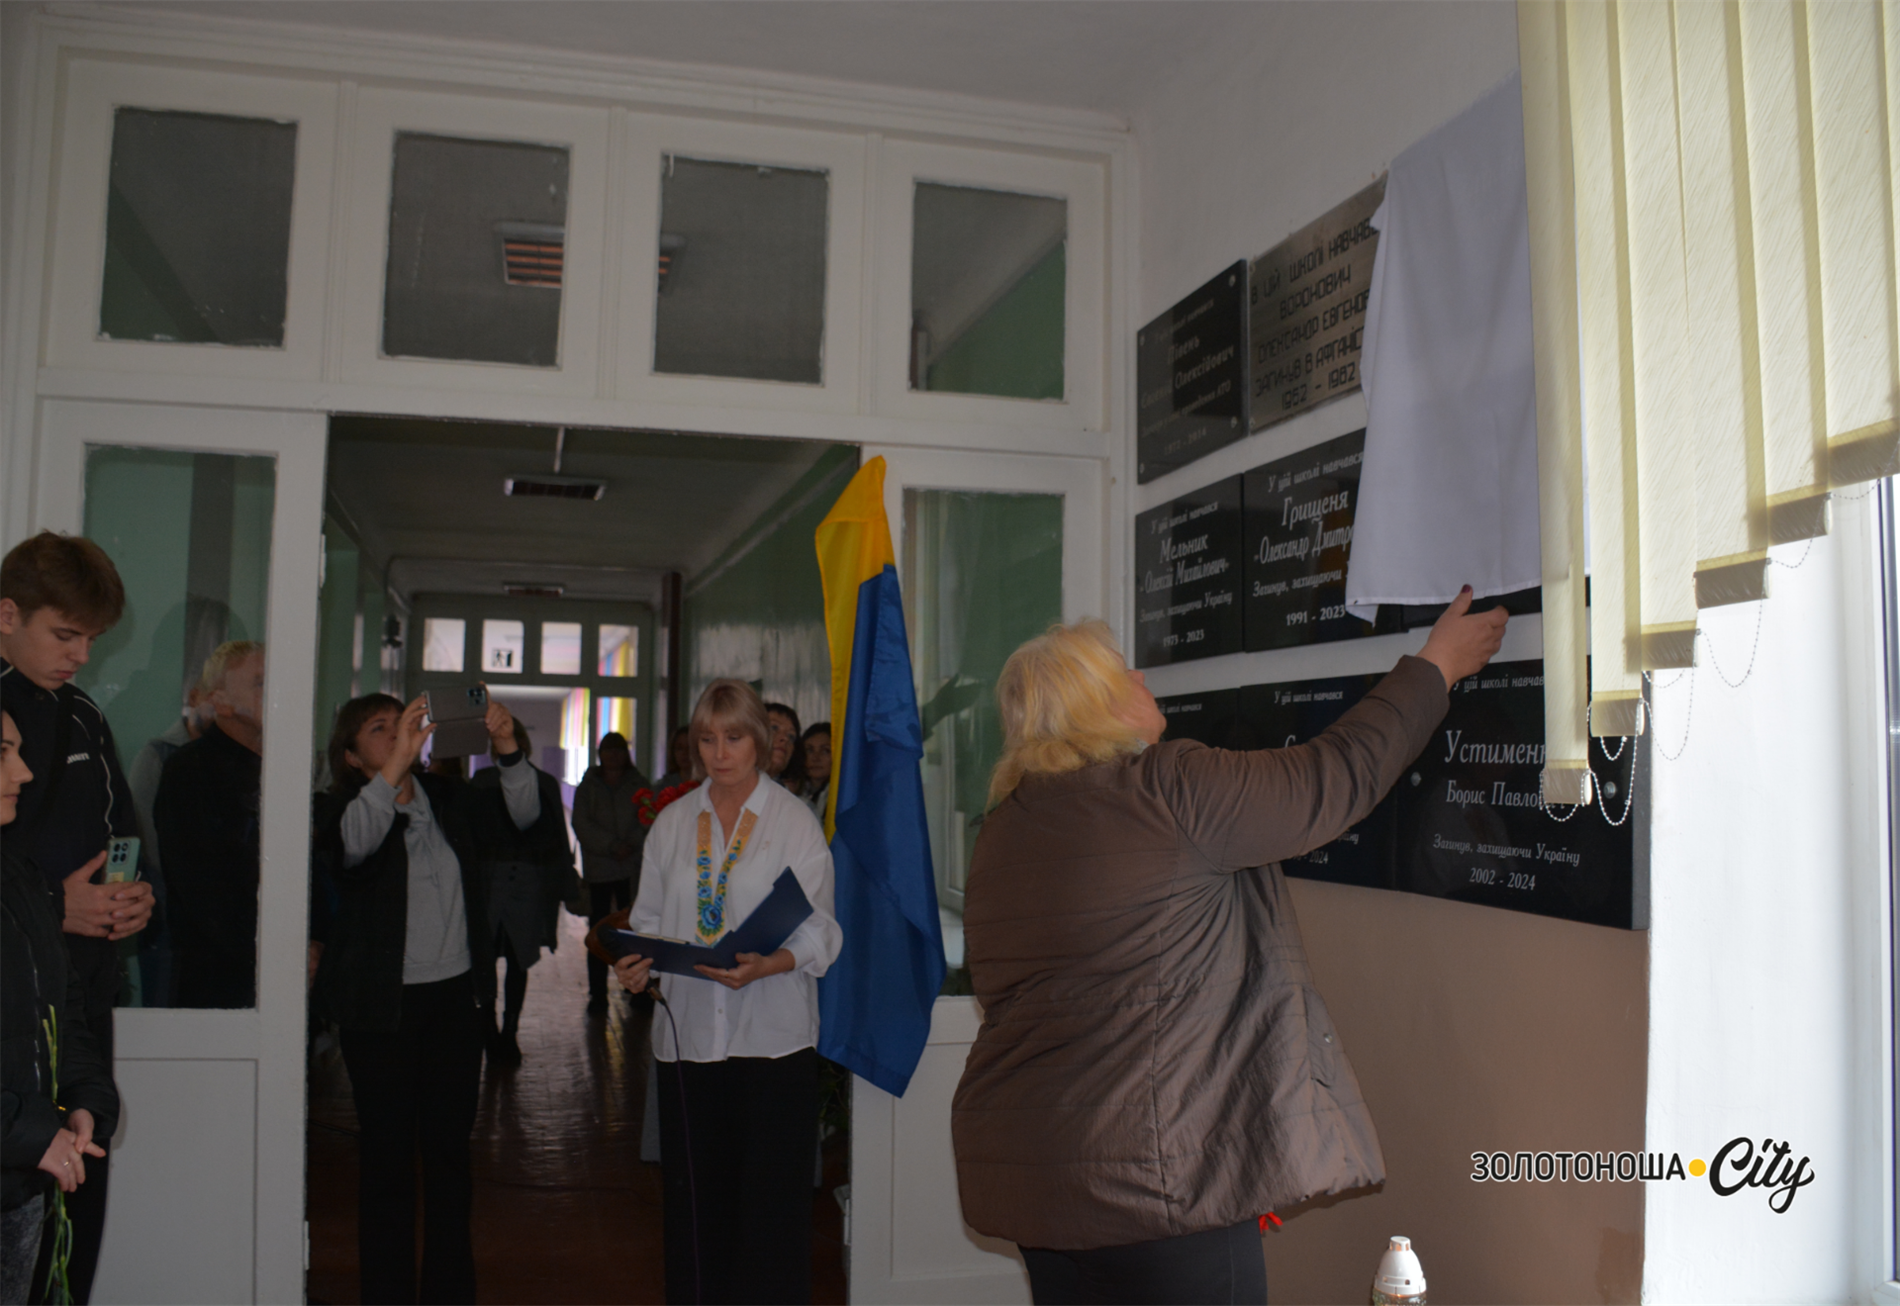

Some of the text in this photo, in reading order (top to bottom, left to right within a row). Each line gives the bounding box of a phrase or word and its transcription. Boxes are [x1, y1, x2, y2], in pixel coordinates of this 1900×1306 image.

[1251, 285, 1258, 306] В
[1289, 240, 1324, 283] ШКОЛІ
[1279, 263, 1352, 321] ВОРОНОВИЧ
[1258, 315, 1320, 365] ОЛЕКСАНДР
[1255, 358, 1301, 398] ЗАГИНУВ
[1305, 352, 1313, 375] В
[1328, 361, 1356, 391] 1982
[1268, 475, 1277, 493] У
[1294, 460, 1320, 485] школі
[1281, 489, 1349, 531] Грищеня
[1159, 533, 1209, 564] Мельник
[1259, 535, 1310, 565] Олександр
[1286, 610, 1308, 626] 1991
[1320, 603, 1346, 621] 2023
[1481, 674, 1508, 689] школі
[1446, 779, 1566, 810] Борис Павло
[1309, 850, 1329, 864] 2024
[1476, 842, 1532, 860] захищаючи
[1535, 842, 1580, 867] Україну
[1469, 867, 1496, 885] 2002
[1507, 872, 1536, 891] 2024
